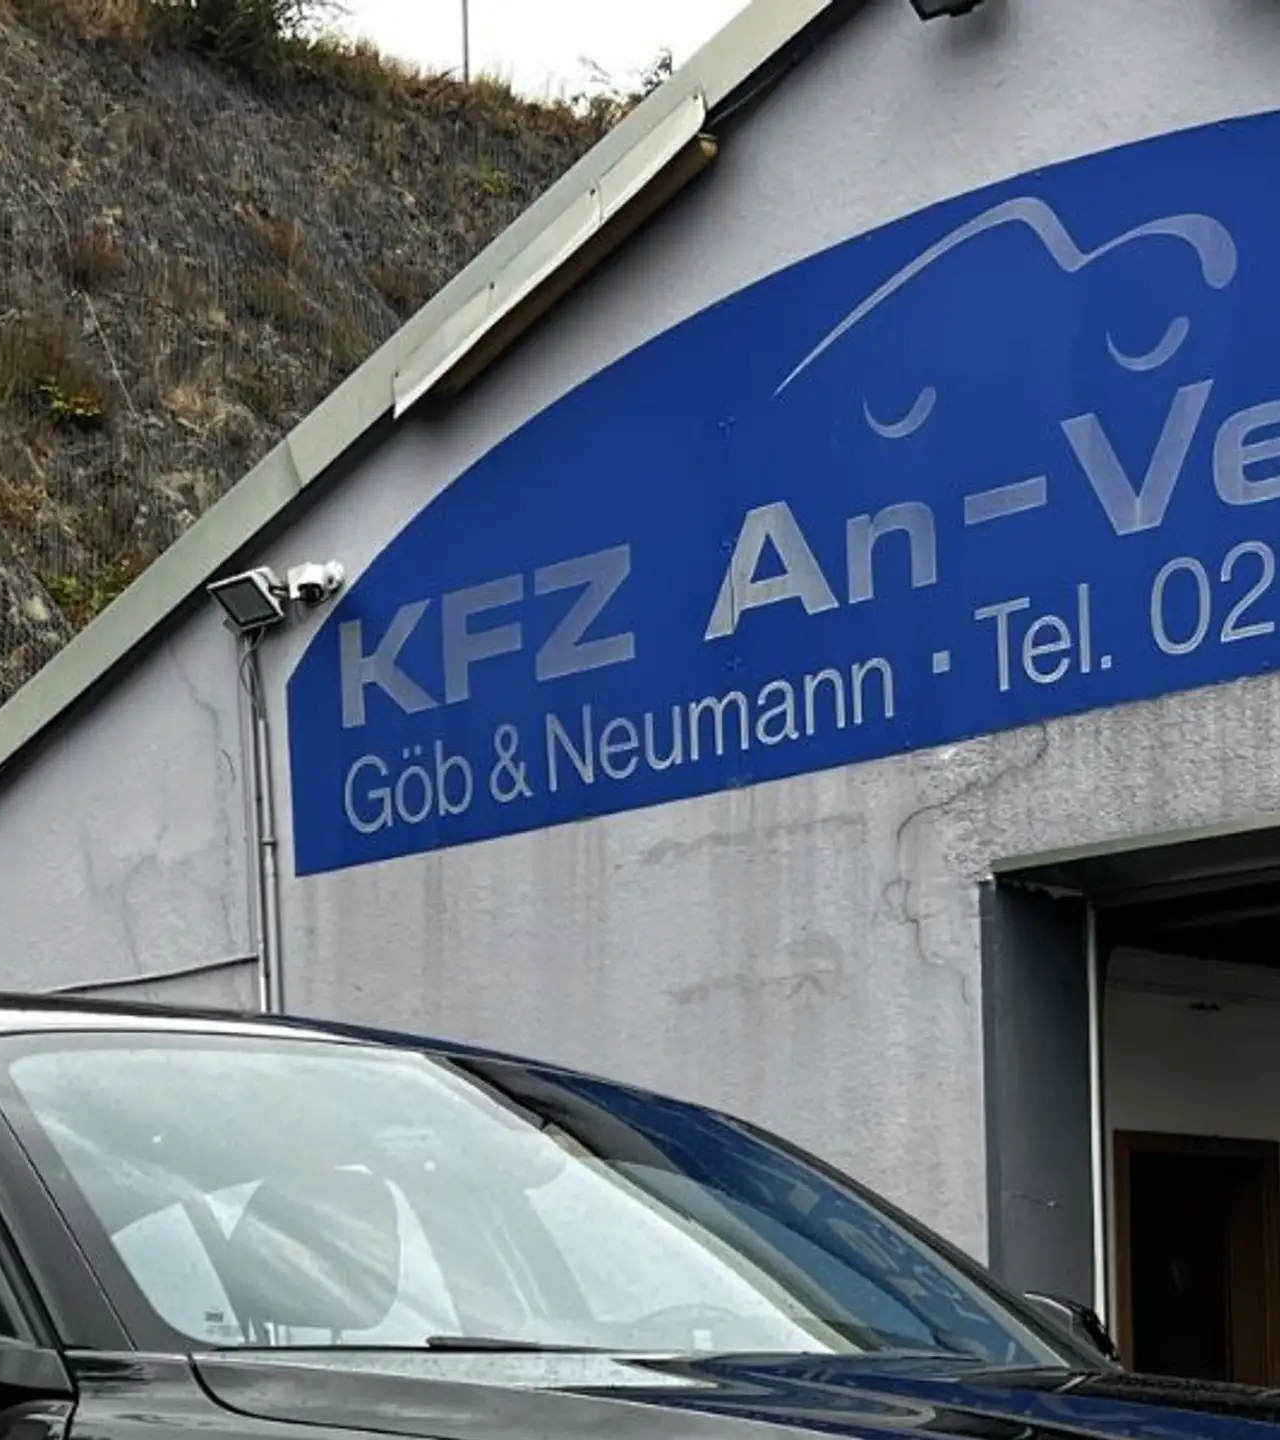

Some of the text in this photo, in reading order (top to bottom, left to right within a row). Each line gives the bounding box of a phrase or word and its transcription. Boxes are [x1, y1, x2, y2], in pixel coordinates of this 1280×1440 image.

[337, 542, 635, 729] KFZ
[343, 734, 474, 835] Göb
[489, 723, 533, 803] &
[544, 655, 895, 794] Neumann
[974, 585, 1113, 692] Tel.
